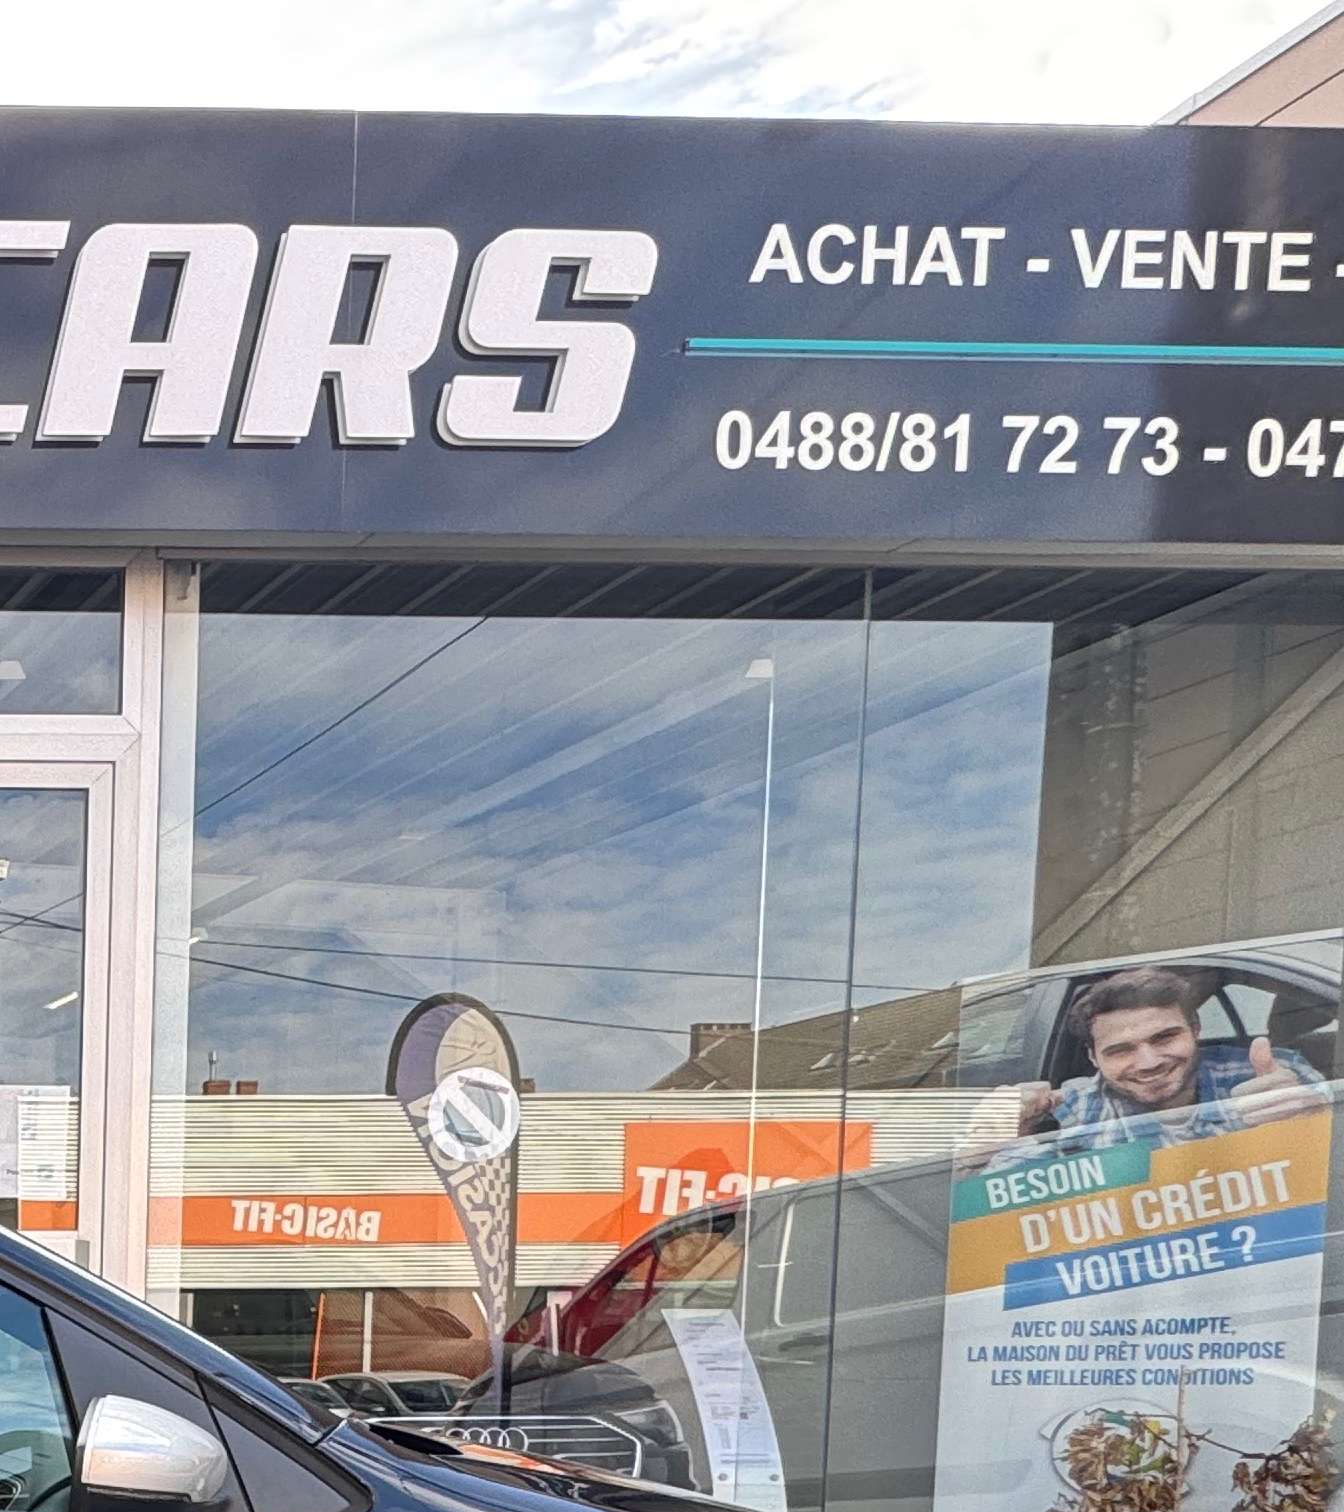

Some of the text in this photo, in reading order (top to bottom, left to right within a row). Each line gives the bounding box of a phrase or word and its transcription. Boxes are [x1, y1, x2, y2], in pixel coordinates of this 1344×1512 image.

[749, 223, 1314, 293] ACHAT - VENTE
[715, 410, 971, 474] 0488/81
[1002, 414, 1080, 474] 72
[1102, 416, 1180, 477] 73
[1202, 446, 1228, 462] -
[985, 1155, 1107, 1209] BESOIN
[1019, 1160, 1292, 1254] D'UN CRÉDIT
[1055, 1225, 1257, 1296] VOITURE ?
[967, 1340, 1287, 1363] LA MAISON DU PRÊT VOUS PROPOSE
[1011, 1316, 1237, 1338] AVEC OU SANS ACOMPTE,
[991, 1369, 1022, 1386] LES
[1026, 1368, 1136, 1386] MEILLEURES
